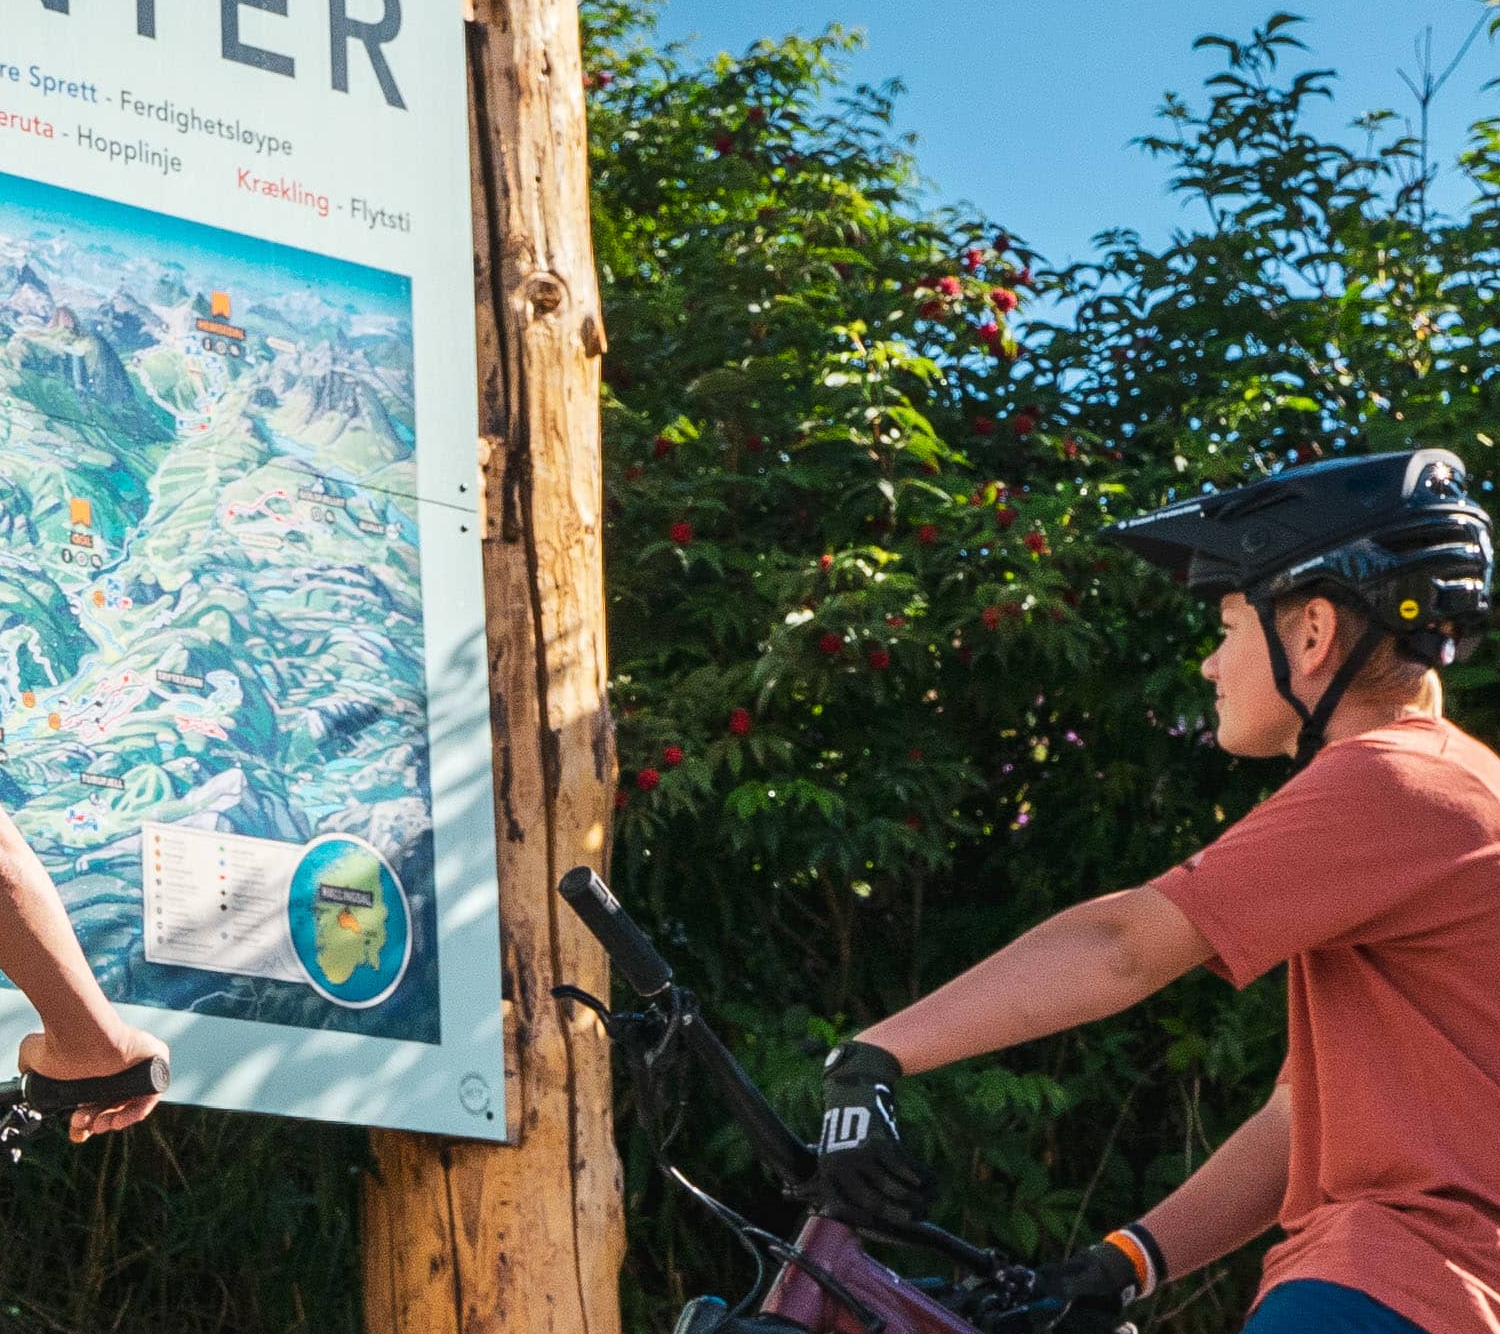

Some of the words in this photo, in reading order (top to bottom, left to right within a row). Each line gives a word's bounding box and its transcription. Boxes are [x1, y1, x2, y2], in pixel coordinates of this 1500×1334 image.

[29, 66, 98, 104] Sprett
[120, 90, 294, 158] Ferdighetsløype
[77, 127, 183, 176] Hopplinje
[237, 167, 331, 218] Krækling
[351, 198, 412, 234] Flytsti
